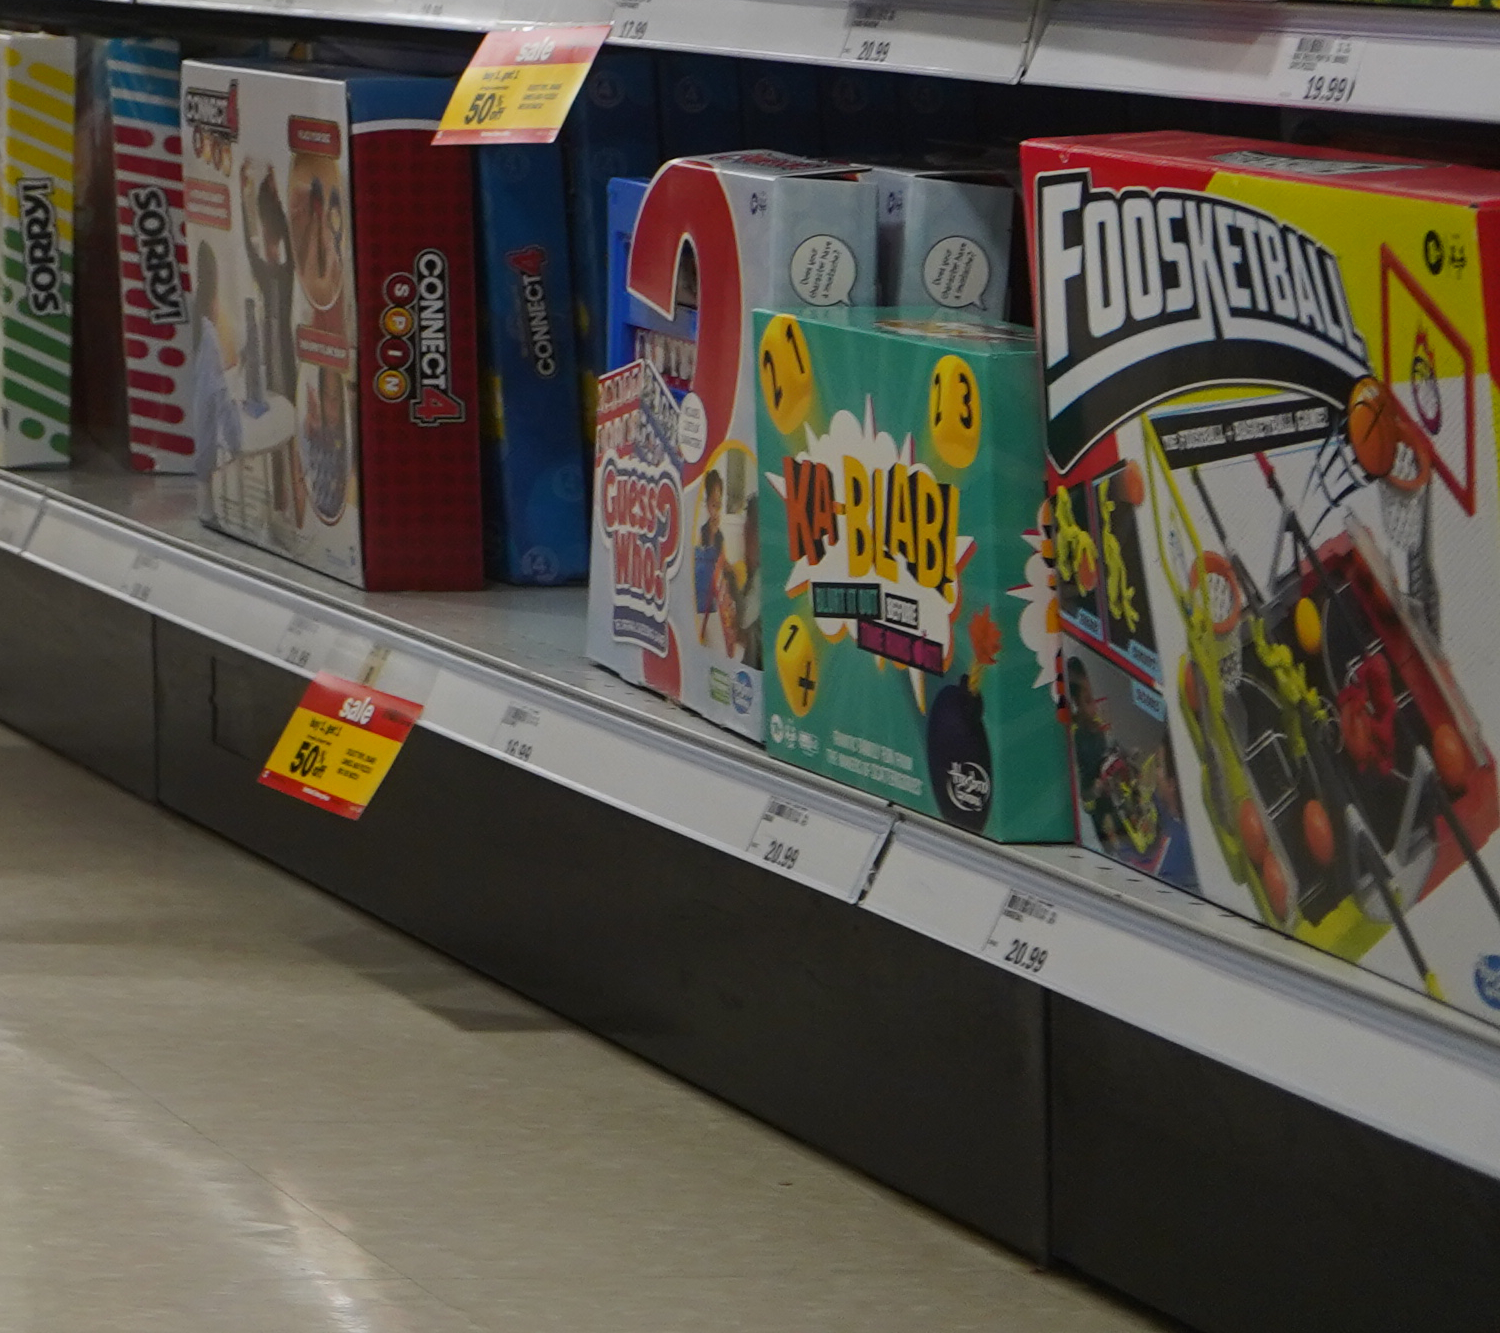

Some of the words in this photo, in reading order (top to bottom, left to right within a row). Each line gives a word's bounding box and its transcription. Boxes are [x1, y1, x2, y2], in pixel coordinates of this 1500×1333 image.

[515, 37, 556, 65] sale
[855, 39, 890, 64] 20.99
[23, 179, 61, 315] SORRY!
[128, 187, 186, 325] SORRY!
[508, 243, 548, 275] 4
[1043, 181, 1364, 369] FOOSKETBALL
[376, 273, 417, 402] SPIN
[416, 250, 447, 389] CONNECT
[534, 275, 555, 378] CONNECT
[411, 386, 464, 425] 4
[605, 470, 656, 535] Guess
[785, 453, 961, 604] KA-BLAB!
[339, 694, 376, 726] sale
[762, 839, 800, 871] 20.99
[1003, 937, 1049, 973] 20.99
